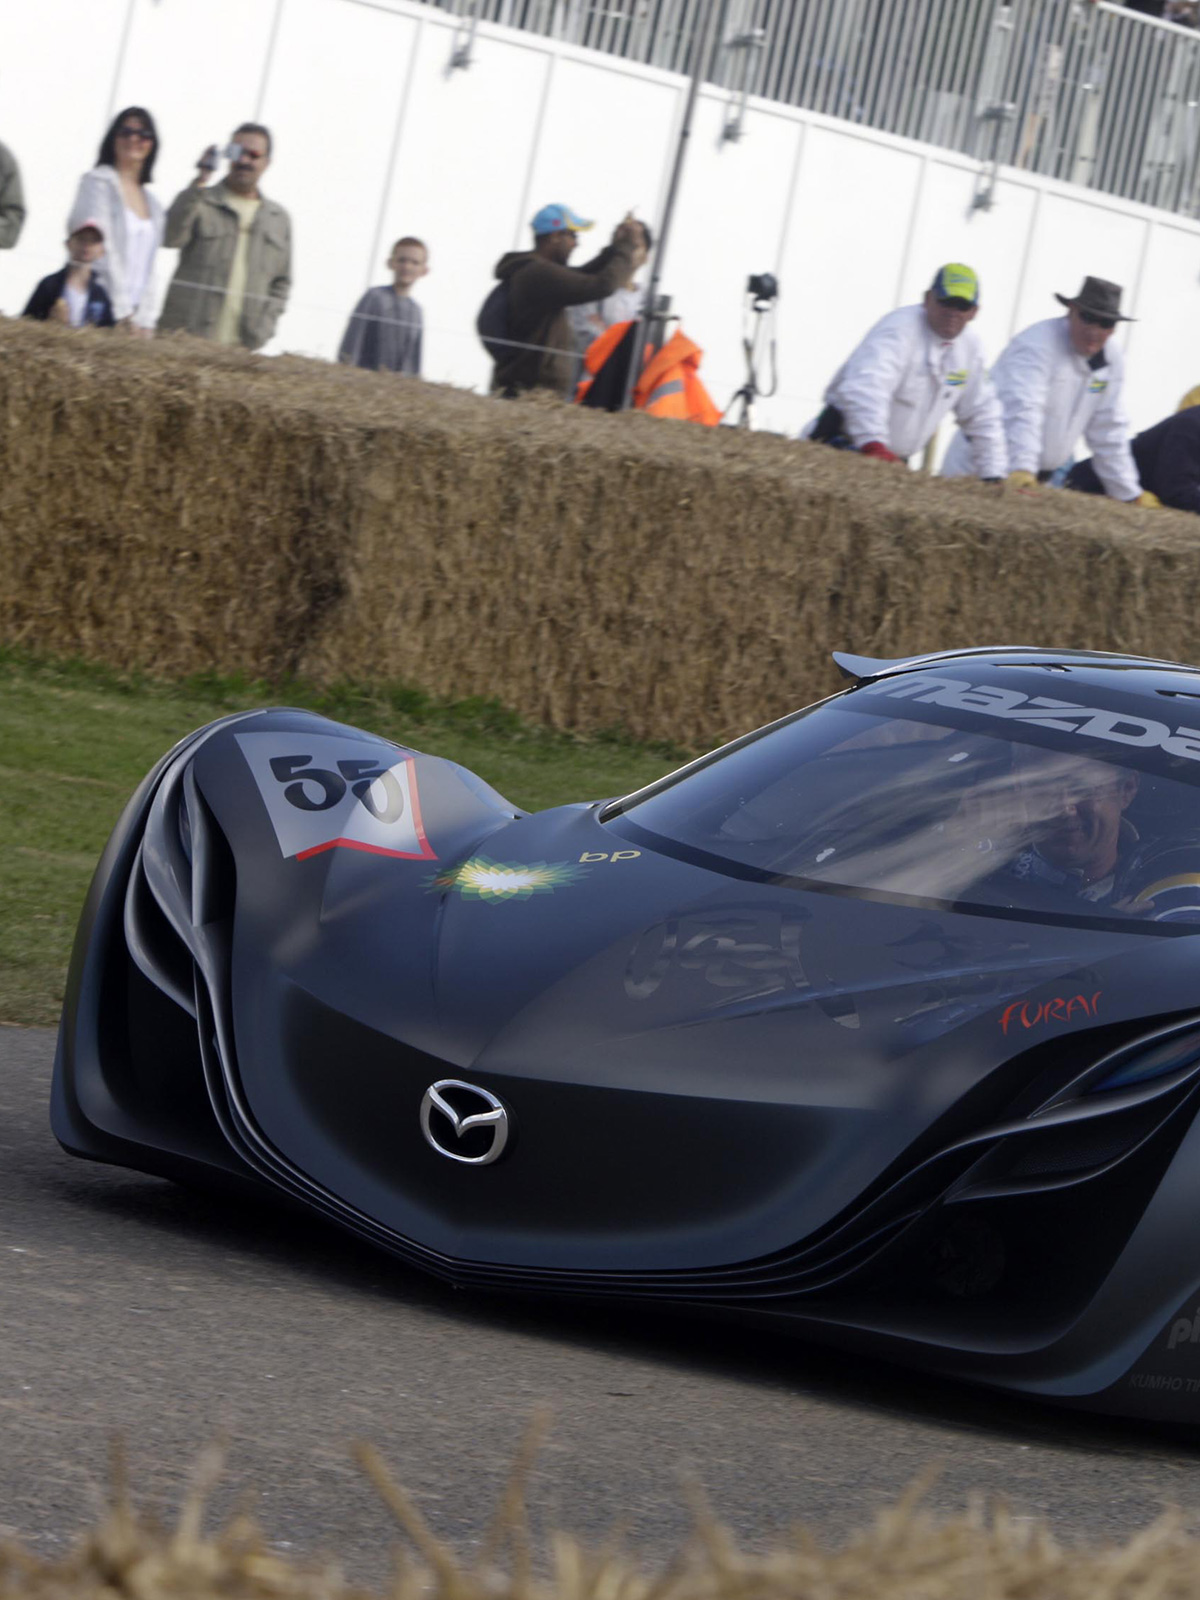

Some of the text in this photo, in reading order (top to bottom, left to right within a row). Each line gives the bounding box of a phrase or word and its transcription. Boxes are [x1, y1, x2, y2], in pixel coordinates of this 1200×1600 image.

[269, 755, 404, 824] 55
[578, 850, 642, 863] bp
[1129, 1373, 1183, 1391] KUMHO
